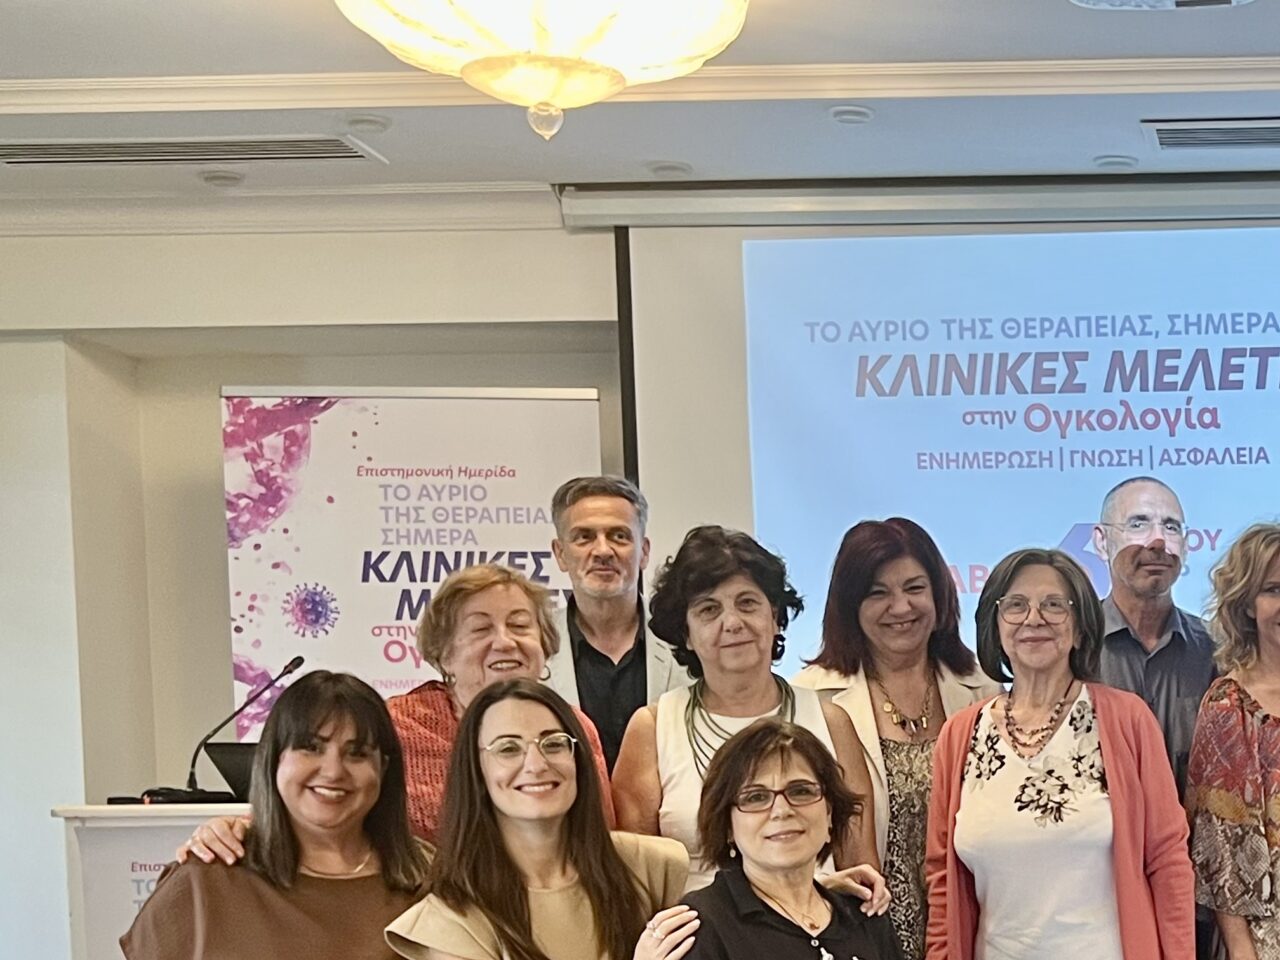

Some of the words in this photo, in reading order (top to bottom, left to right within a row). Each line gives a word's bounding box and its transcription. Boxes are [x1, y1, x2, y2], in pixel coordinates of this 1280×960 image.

[805, 322, 841, 343] ΤΟ
[848, 319, 930, 343] ΑΥΡΙΟ
[941, 318, 993, 341] ΤΗΣ
[1001, 314, 1161, 340] ΘΕΡΑΠΕΙΑΣ,
[1167, 311, 1280, 336] ΣΗΜΕΡΑ
[855, 350, 1089, 398] ΚΛΙΝΙΚΕΣ
[962, 408, 1016, 430] στην
[1023, 397, 1221, 440] Ογκολογία
[916, 450, 1053, 471] ΕΝΗΜΕΡΩΣΗ
[1069, 447, 1143, 469] ΓΝΩΣΗ
[1159, 444, 1270, 466] ΑΣΦΑΛΕΙΑ
[356, 465, 453, 480] Επιστημονική
[457, 465, 516, 479] Ημερίδα
[379, 485, 411, 501] ΤΟ
[417, 484, 488, 501] ΑΥΡΙΟ
[379, 507, 426, 524] ΤΗΣ
[432, 506, 552, 525] ΘΕΡΑΠΕΙΑ
[381, 529, 478, 546] ΣΗΜΕΡΑ
